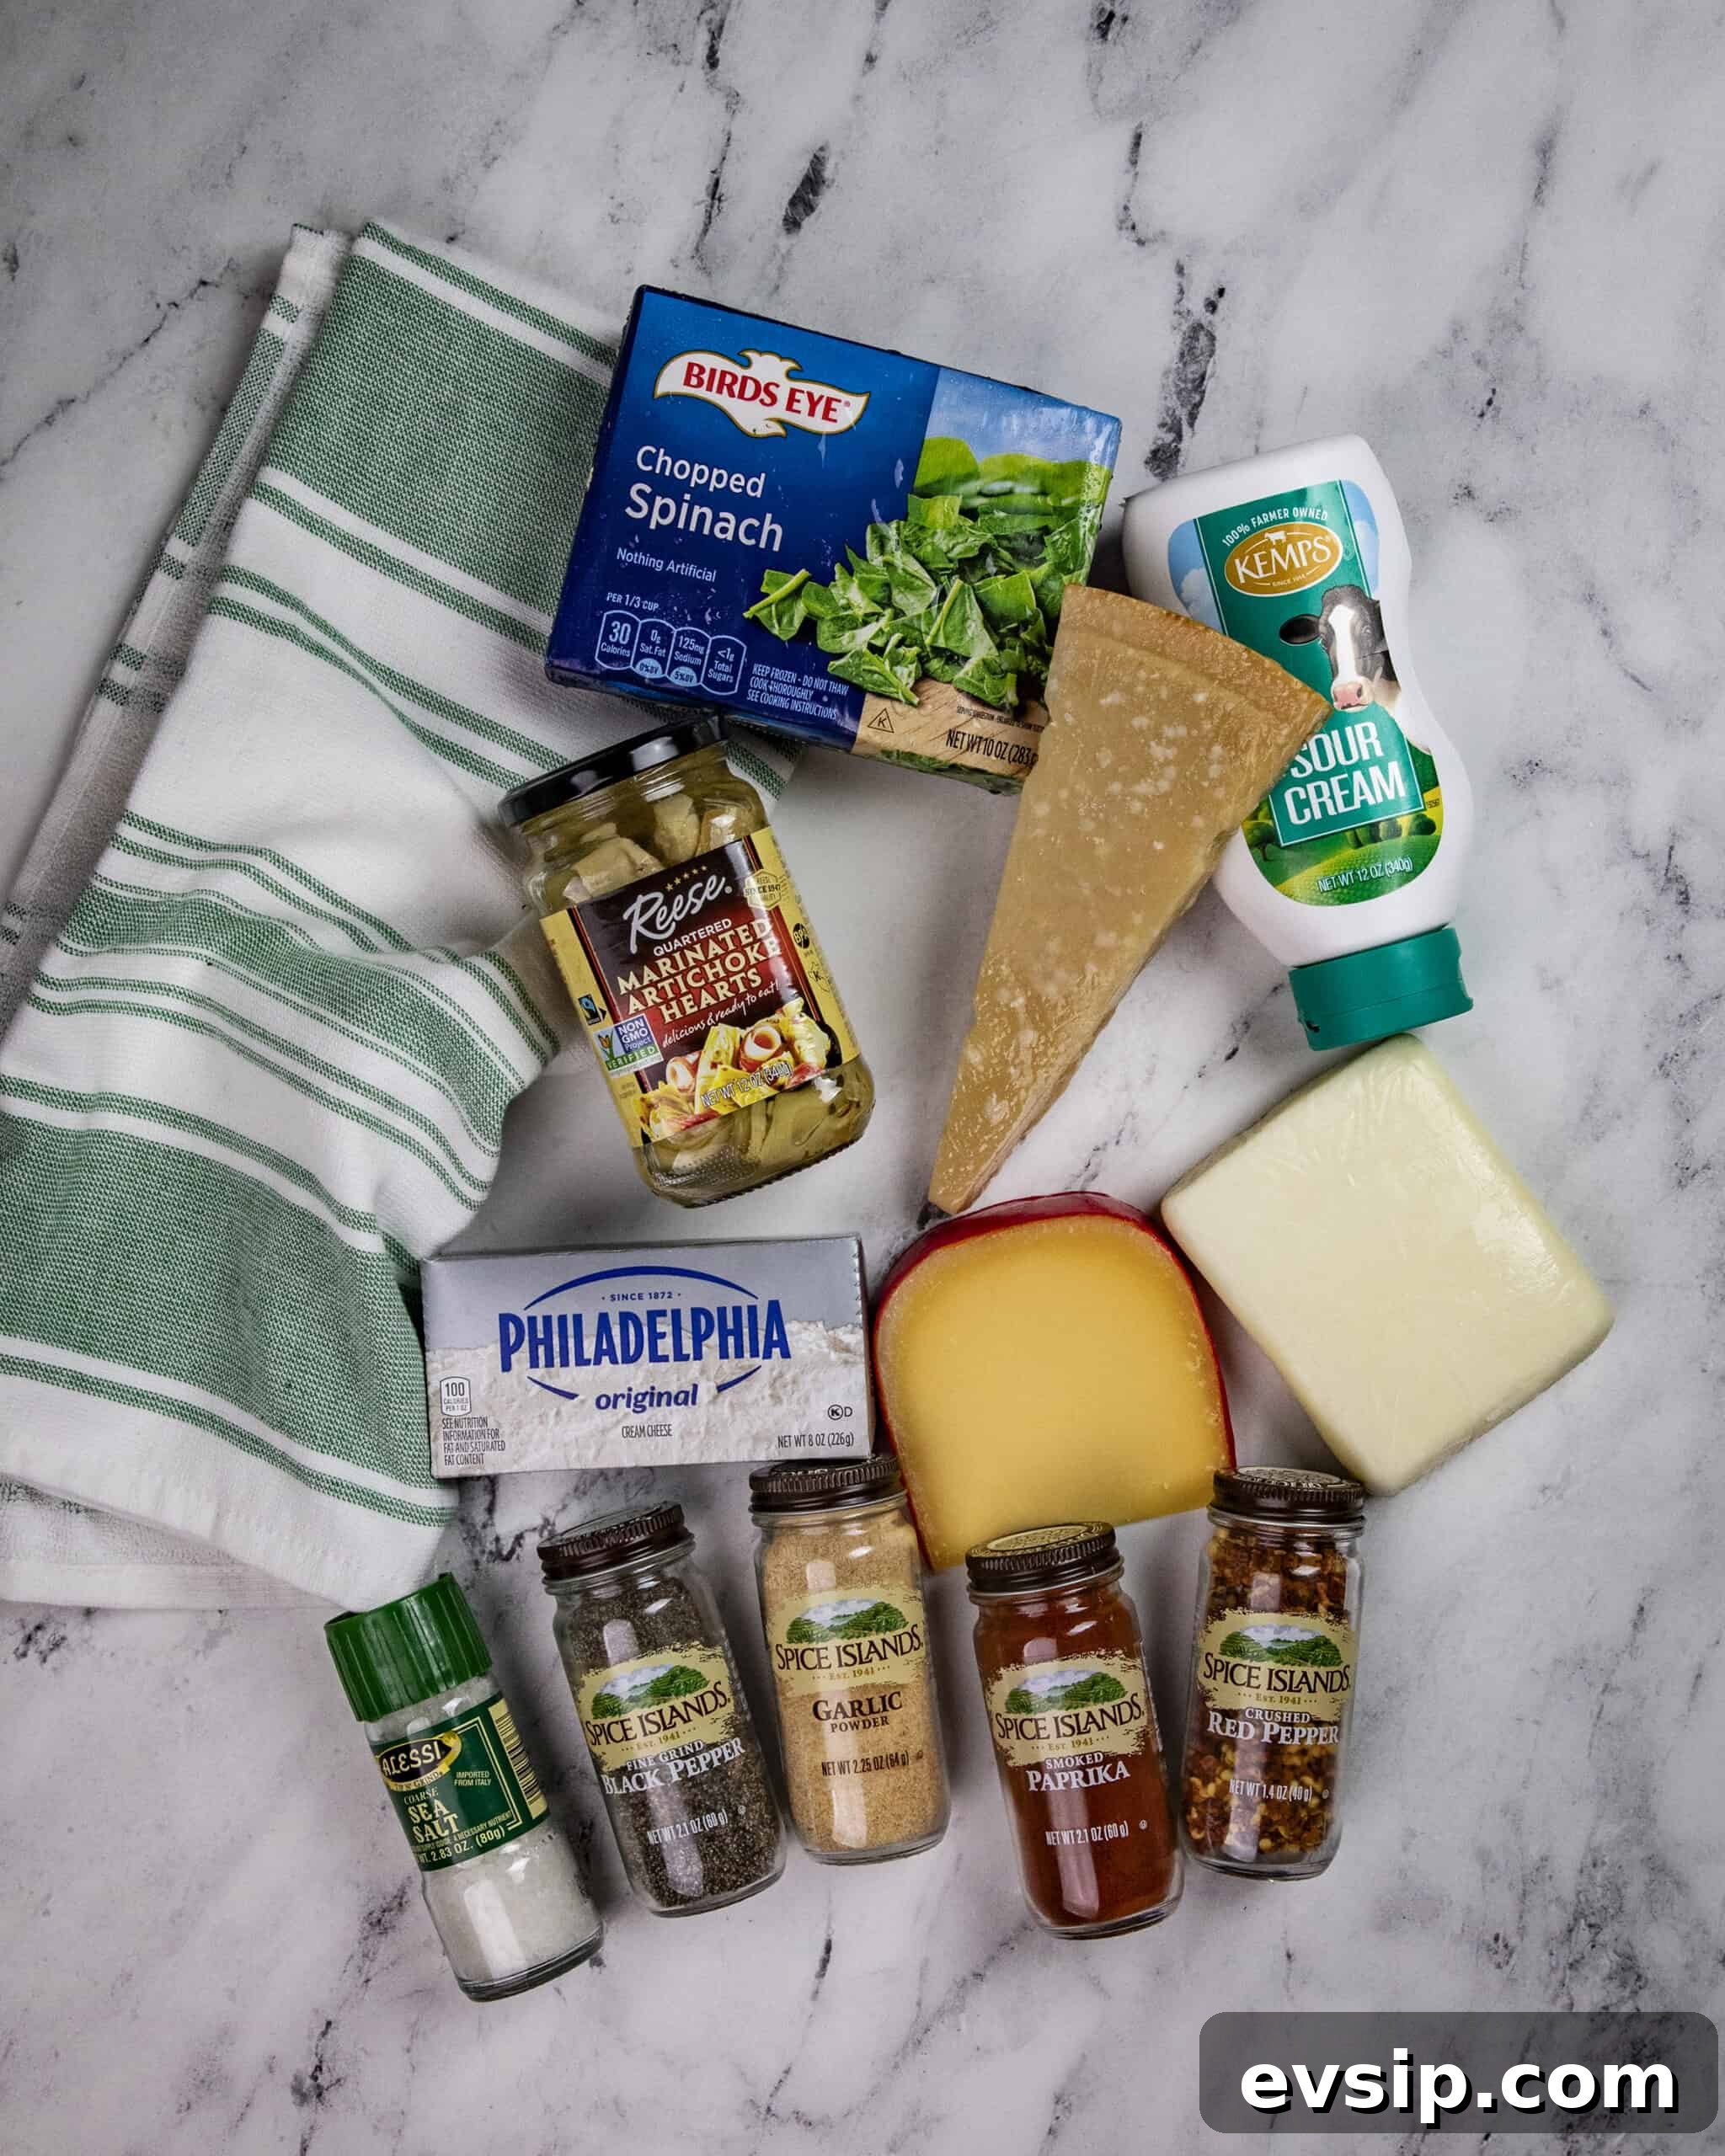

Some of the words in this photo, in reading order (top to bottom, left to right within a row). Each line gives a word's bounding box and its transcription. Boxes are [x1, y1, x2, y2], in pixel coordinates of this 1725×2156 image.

[683, 361, 780, 407] BIRDS
[785, 387, 841, 423] EYE
[636, 446, 766, 498] Chopped
[625, 483, 783, 552] Spinach
[1222, 523, 1250, 547] 100%
[1251, 507, 1290, 529] FARMER
[1293, 507, 1328, 521] OWNED
[616, 547, 664, 574] Nothing
[666, 558, 717, 584] Artificial
[1234, 536, 1332, 583] KEMPS
[606, 592, 622, 604] PER
[624, 594, 641, 608] 1/3
[642, 600, 660, 611] CUP
[609, 621, 632, 645] 30
[650, 630, 661, 643] 0g
[601, 642, 630, 658] Calories
[674, 651, 702, 665] Sodium
[718, 647, 734, 662] <1g
[708, 670, 734, 683] Sugars
[714, 660, 733, 672] Total
[752, 664, 769, 676] KEEP
[770, 667, 796, 682] FROZEN
[802, 675, 814, 687] DO
[814, 678, 827, 691] NOT
[828, 680, 849, 695] THAW
[750, 677, 768, 690] COOK
[768, 680, 814, 701] THOROUGHLY
[746, 691, 759, 703] SEE
[760, 693, 789, 710] COOKING
[789, 699, 836, 721] INSTRUCTIONS
[946, 728, 964, 750] NET
[968, 734, 983, 752] WT
[983, 737, 994, 757] 10
[995, 739, 1008, 760] OZ
[1290, 721, 1384, 778] SOUR
[1284, 761, 1406, 825] CREAM
[1318, 876, 1338, 894] NET
[1338, 871, 1356, 885] WT
[1357, 867, 1370, 882] 12
[1370, 864, 1384, 879] OZ
[1385, 857, 1414, 877] (340g)
[622, 874, 727, 954] Reese
[653, 918, 733, 958] QUARTERED
[617, 918, 774, 995] MARINATED
[628, 937, 783, 1017] ARTICHOKE
[659, 968, 762, 1025] HEARTS
[618, 1018, 645, 1035] NON
[622, 1027, 649, 1043] GMO
[662, 1021, 707, 1049] delicious
[714, 1002, 746, 1023] ready
[745, 995, 756, 1006] to
[625, 1037, 651, 1051] Project
[607, 1046, 655, 1070] VERIFIED
[701, 1089, 720, 1107] NET
[718, 1084, 735, 1099] WT
[737, 1078, 750, 1092] 12
[750, 1072, 764, 1088] OZ
[609, 1292, 645, 1302] SINCE
[648, 1290, 673, 1300] 1872
[499, 1299, 792, 1374] PHILADELPHIA
[445, 1381, 465, 1396] 100
[595, 1383, 698, 1414] original
[442, 1418, 454, 1430] SEE
[454, 1417, 489, 1429] NUTRITION
[443, 1429, 487, 1441] INFORMATION
[488, 1428, 499, 1439] FOR
[622, 1424, 646, 1438] CREAM
[647, 1423, 673, 1437] CHEESE
[443, 1443, 454, 1454] FAT
[454, 1442, 469, 1453] AND
[469, 1440, 506, 1452] SATURATED
[777, 1435, 792, 1449] NET
[794, 1434, 806, 1447] WT
[809, 1434, 814, 1446] 8
[815, 1433, 825, 1446] OZ
[827, 1432, 854, 1447] (226g)
[444, 1454, 455, 1466] FAT
[456, 1453, 484, 1465] CONTENT
[775, 1643, 832, 1672] SPICE
[836, 1624, 923, 1669] ISLANDS
[852, 1666, 874, 1678] 1941
[1204, 1652, 1262, 1689] SPICE
[1266, 1664, 1351, 1694] ISLANDS
[812, 1691, 903, 1721] GARLIC
[1279, 1694, 1301, 1705] 1941
[585, 1717, 638, 1746] SPICE
[637, 1681, 728, 1737] ISLANDS
[830, 1716, 890, 1733] POWDER
[995, 1713, 1050, 1740] SPICE
[1052, 1693, 1144, 1738] ISLANDS
[1245, 1707, 1311, 1724] CRUSHED
[659, 1731, 681, 1744] 1941
[1207, 1710, 1255, 1741] RED
[1261, 1721, 1341, 1746] PEPPER
[626, 1757, 655, 1772] FINE
[659, 1740, 705, 1763] GRIND
[1071, 1737, 1093, 1748] 1941
[382, 1741, 441, 1777] ALESSI
[601, 1770, 665, 1795] BLACK
[666, 1737, 745, 1782] PEPPER
[821, 1761, 837, 1777] NET
[837, 1760, 852, 1775] WT
[852, 1757, 873, 1774] 2.25
[873, 1755, 884, 1771] OZ
[1045, 1752, 1104, 1770] SMOKED
[454, 1778, 473, 1786] FROM
[1026, 1760, 1131, 1792] PAPRIKA
[404, 1787, 439, 1805] COARSE
[1229, 1779, 1247, 1796] NET
[1247, 1781, 1261, 1797] WT
[1263, 1784, 1274, 1800] 1.4
[1276, 1785, 1289, 1801] OZ
[408, 1798, 451, 1824] SEA
[412, 1815, 459, 1844] SALT
[431, 1847, 452, 1861] 2.83
[454, 1840, 473, 1854] OZ.
[476, 1824, 505, 1847] (80g)
[647, 1829, 660, 1846] NET
[661, 1826, 676, 1841] WT
[676, 1821, 689, 1838] 2.1
[691, 1817, 702, 1834] OZ
[1045, 1828, 1061, 1846] NET
[1062, 1828, 1076, 1844] WT
[1076, 1826, 1090, 1844] 2.1
[1092, 1825, 1103, 1842] OZ
